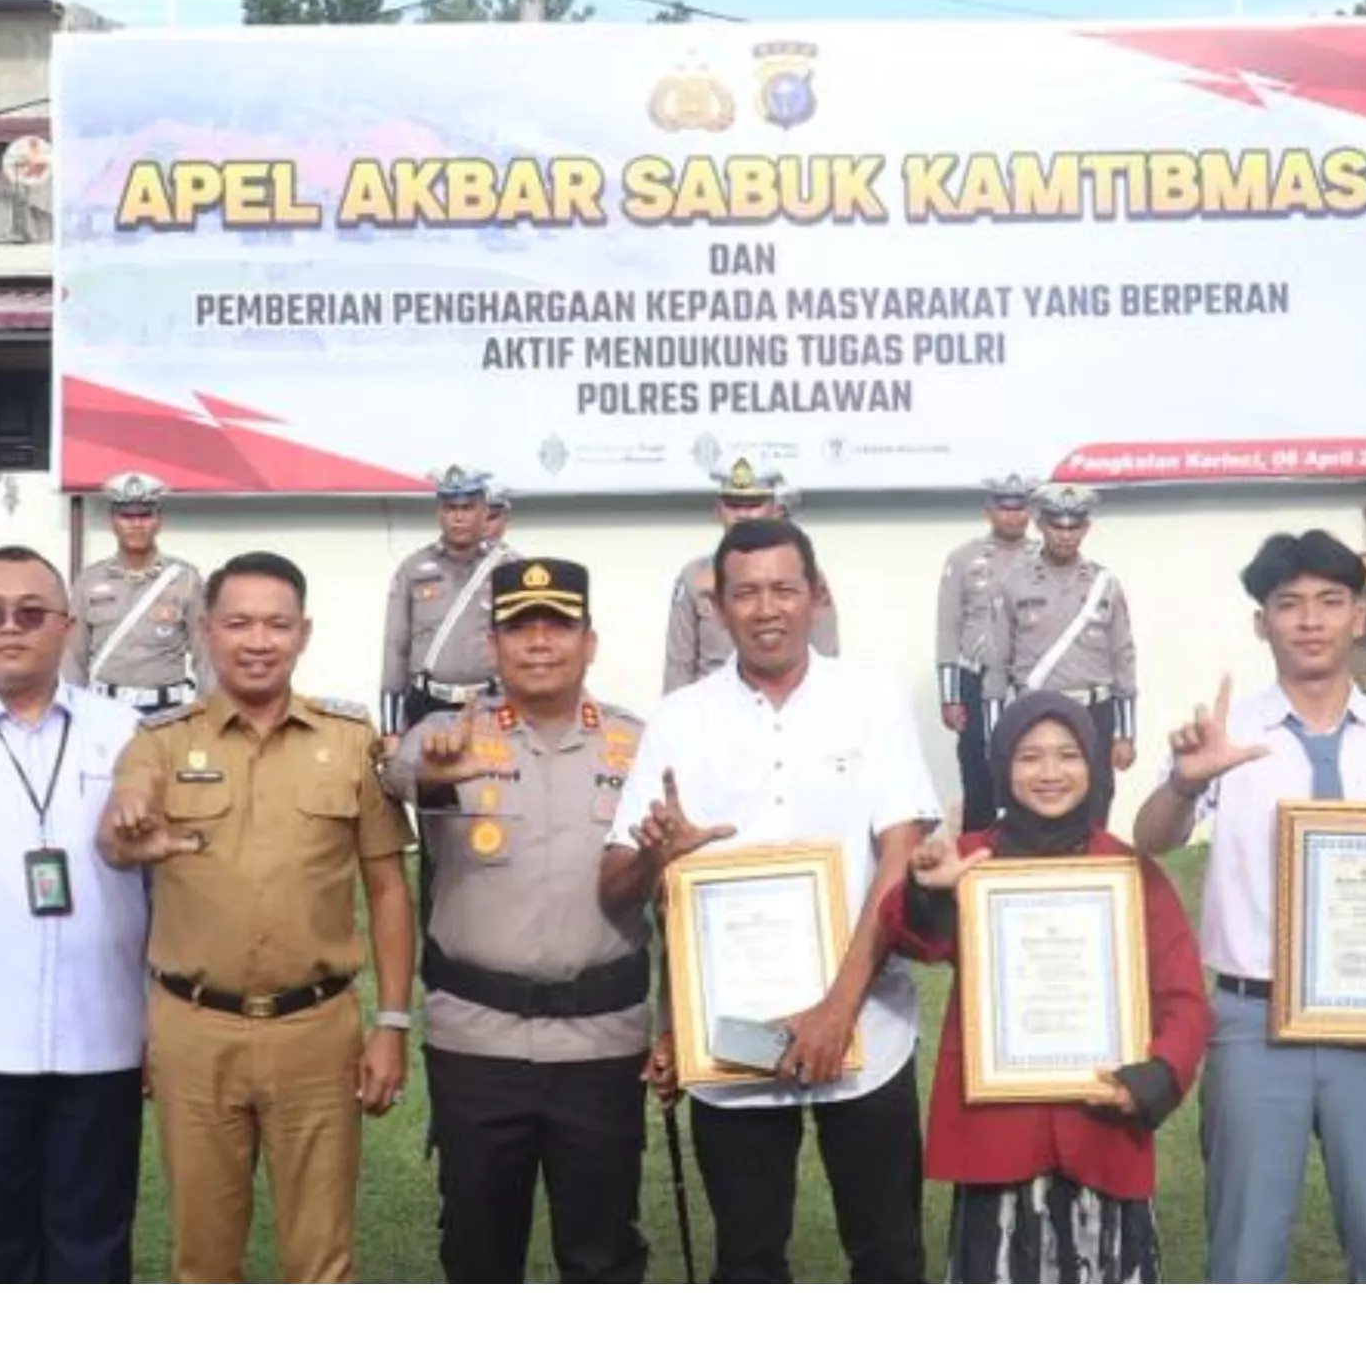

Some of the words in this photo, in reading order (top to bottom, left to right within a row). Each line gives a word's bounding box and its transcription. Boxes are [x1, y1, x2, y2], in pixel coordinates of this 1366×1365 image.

[115, 158, 322, 230] APEL
[336, 156, 607, 228] AKBAR
[621, 153, 889, 226] SABUK
[709, 241, 776, 276] DAN
[196, 292, 382, 326] PEMBERIAN
[391, 289, 635, 324] PENGHARGAAN
[645, 287, 781, 323] KEPADA
[786, 285, 1012, 321] MASYARAKAT
[1023, 283, 1111, 317] YANG
[1120, 282, 1289, 315] BERPERAN
[482, 336, 573, 371] AKTIF
[584, 335, 789, 370] MENDUKUNG
[798, 333, 903, 367] TUGAS
[913, 332, 1006, 365] POLRI
[576, 382, 699, 415] POLRES
[709, 379, 913, 414] PELALAWAN
[1069, 453, 1180, 476] Pangkalan
[1184, 451, 1268, 474] Kerinci,
[1303, 448, 1355, 471] April
